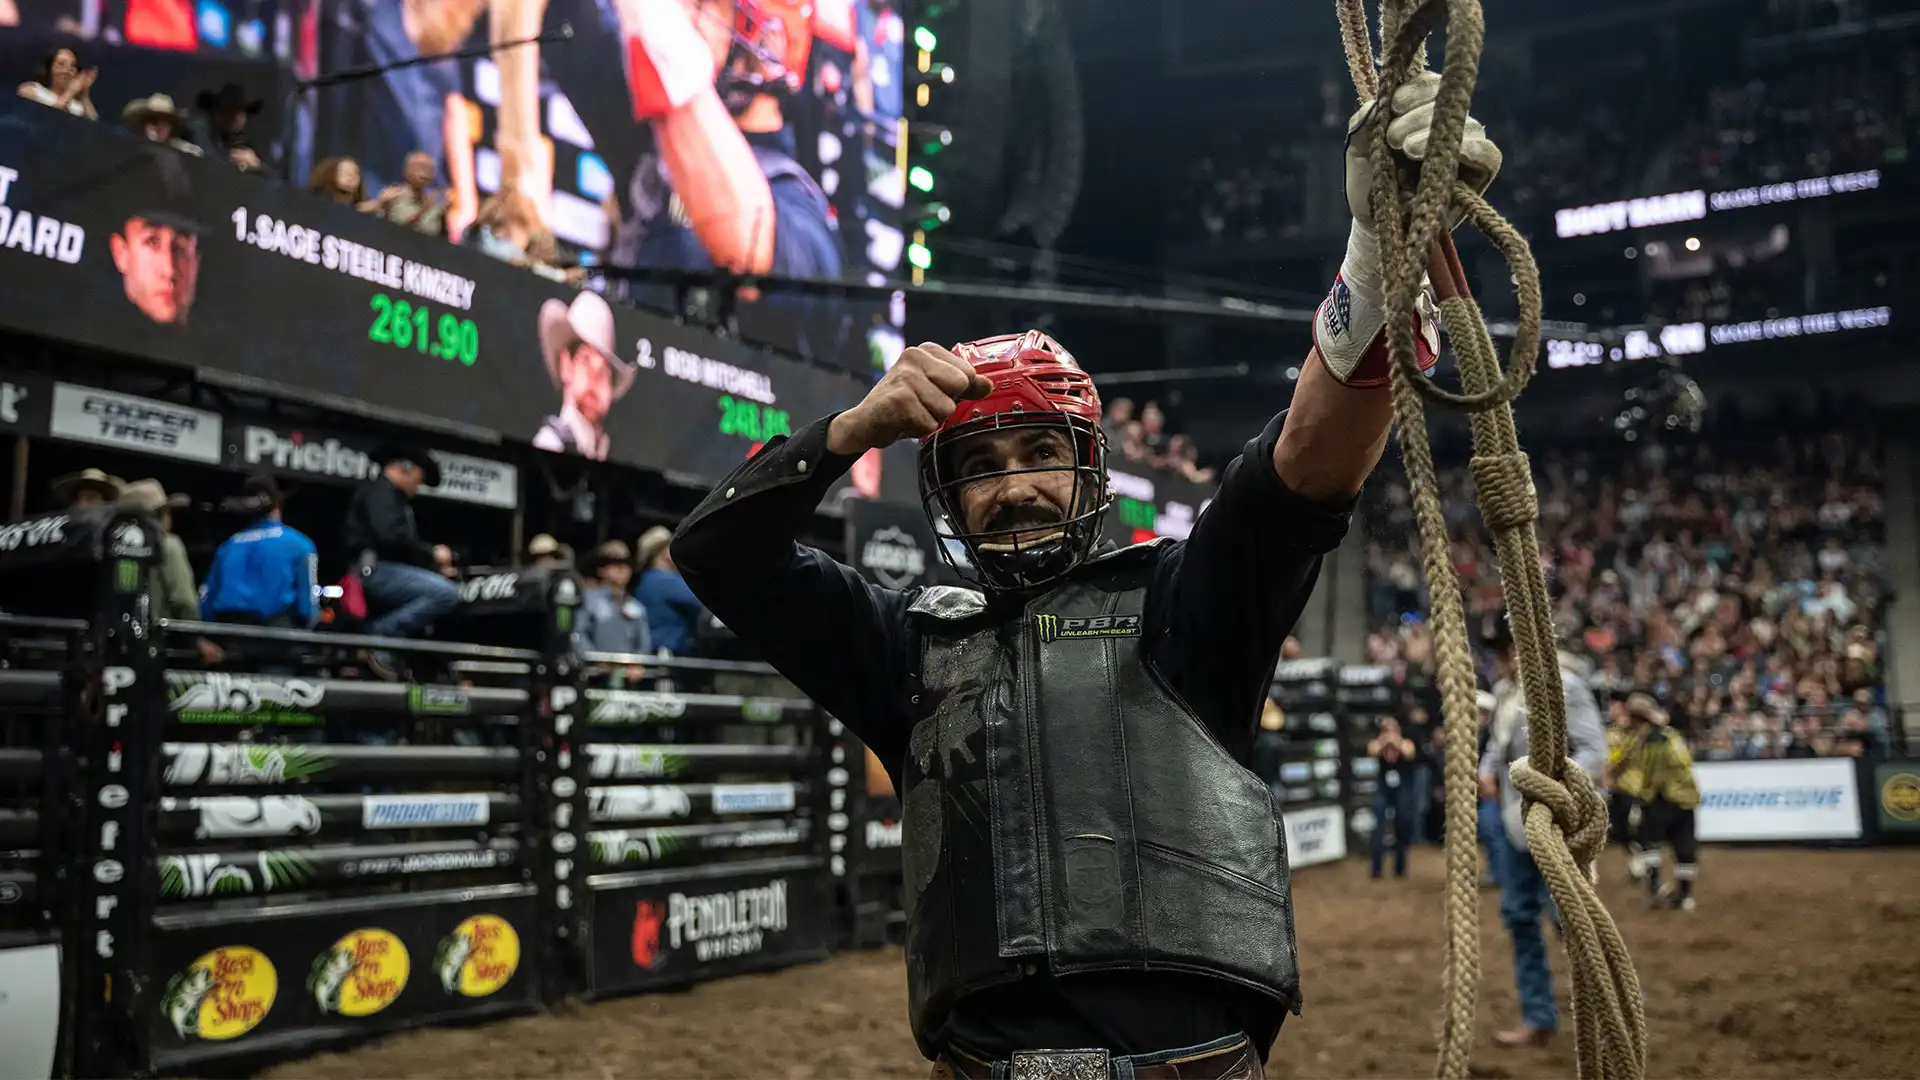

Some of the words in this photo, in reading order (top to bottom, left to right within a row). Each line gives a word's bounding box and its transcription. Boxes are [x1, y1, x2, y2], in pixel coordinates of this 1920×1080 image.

[321, 235, 403, 289] STEELE
[368, 293, 479, 366] 261.90
[636, 337, 656, 369] 2.
[663, 346, 701, 383] BOB
[701, 357, 776, 404] MITCHELL
[1060, 629, 1099, 637] UNLEASH
[667, 879, 787, 949] PENDLETON
[696, 930, 763, 961] WHISKY
